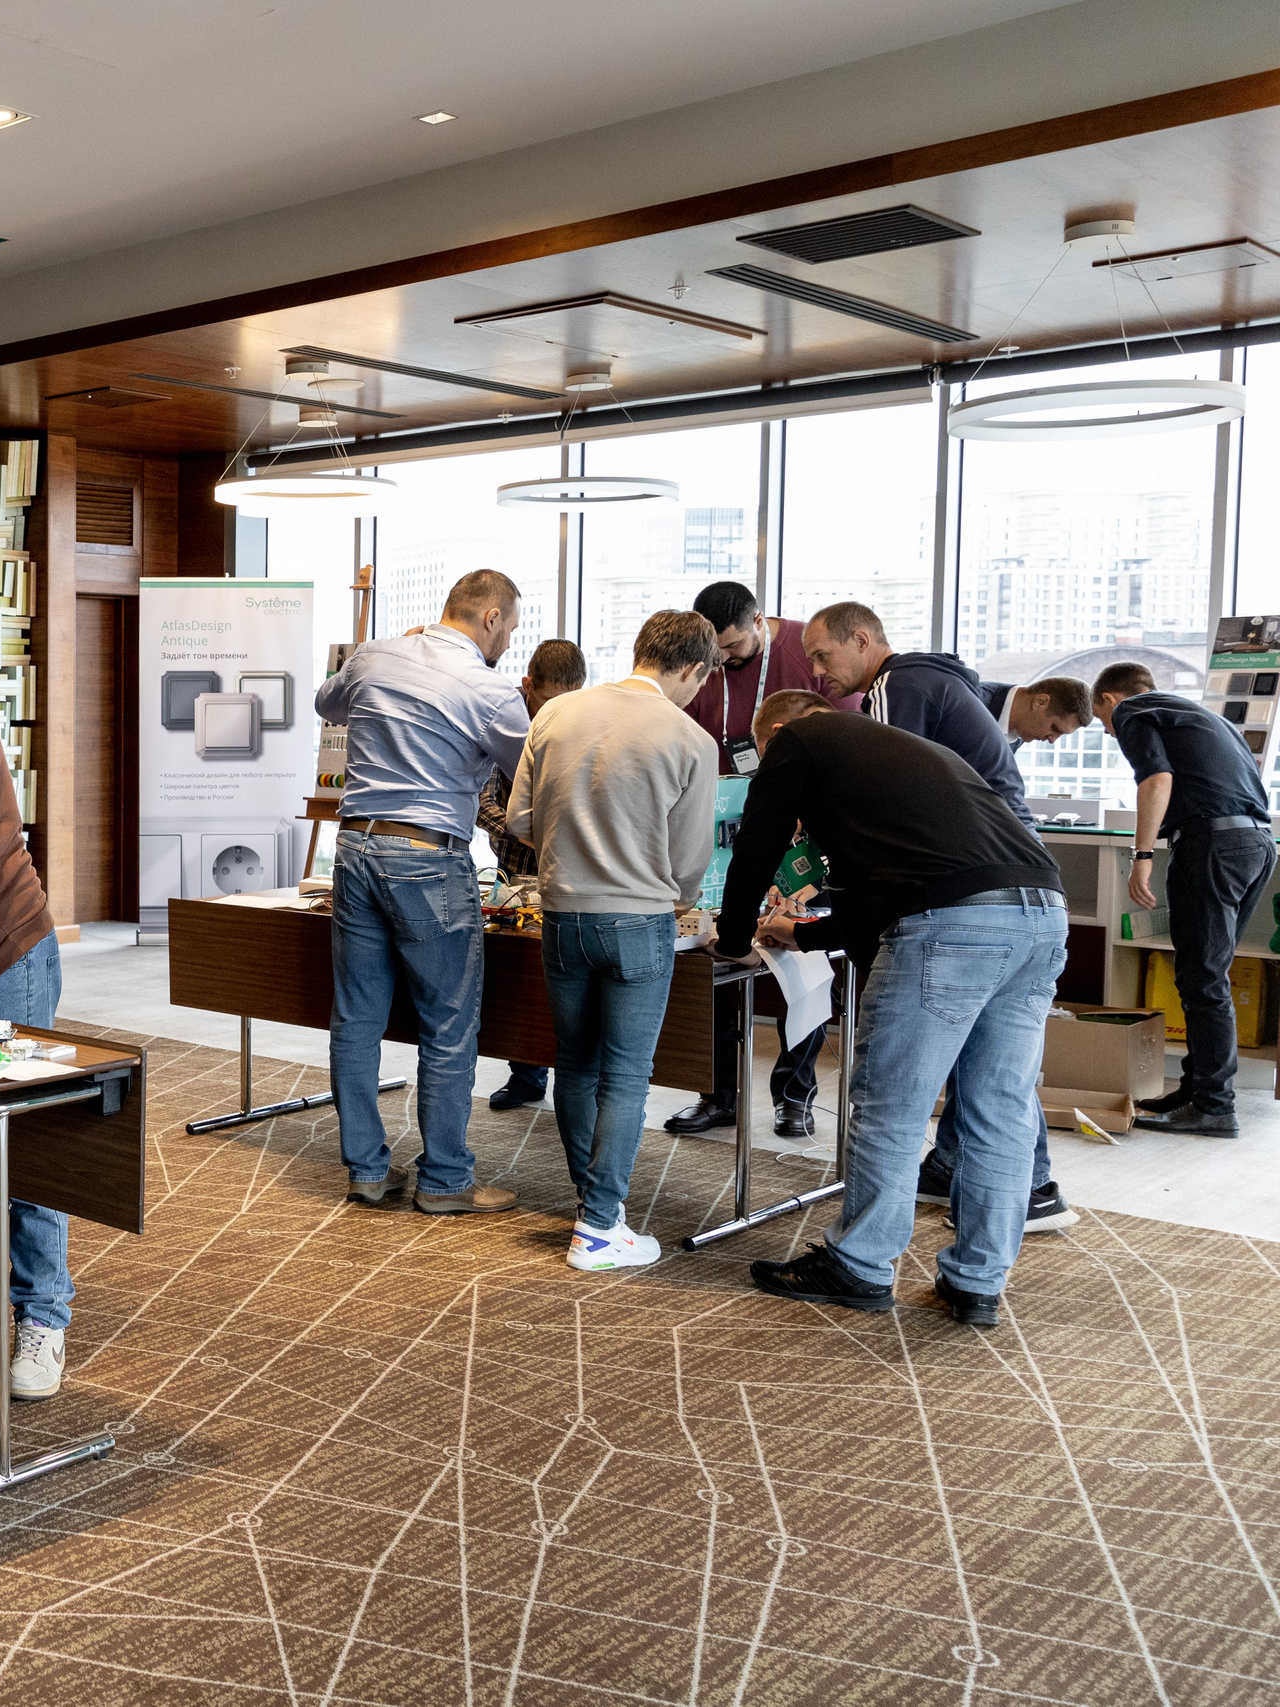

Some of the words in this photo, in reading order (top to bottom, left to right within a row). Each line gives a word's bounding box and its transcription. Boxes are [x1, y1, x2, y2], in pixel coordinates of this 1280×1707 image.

[263, 608, 302, 616] electric
[161, 620, 232, 634] AtlasDesign
[161, 636, 209, 648] Antique
[210, 653, 248, 661] времени
